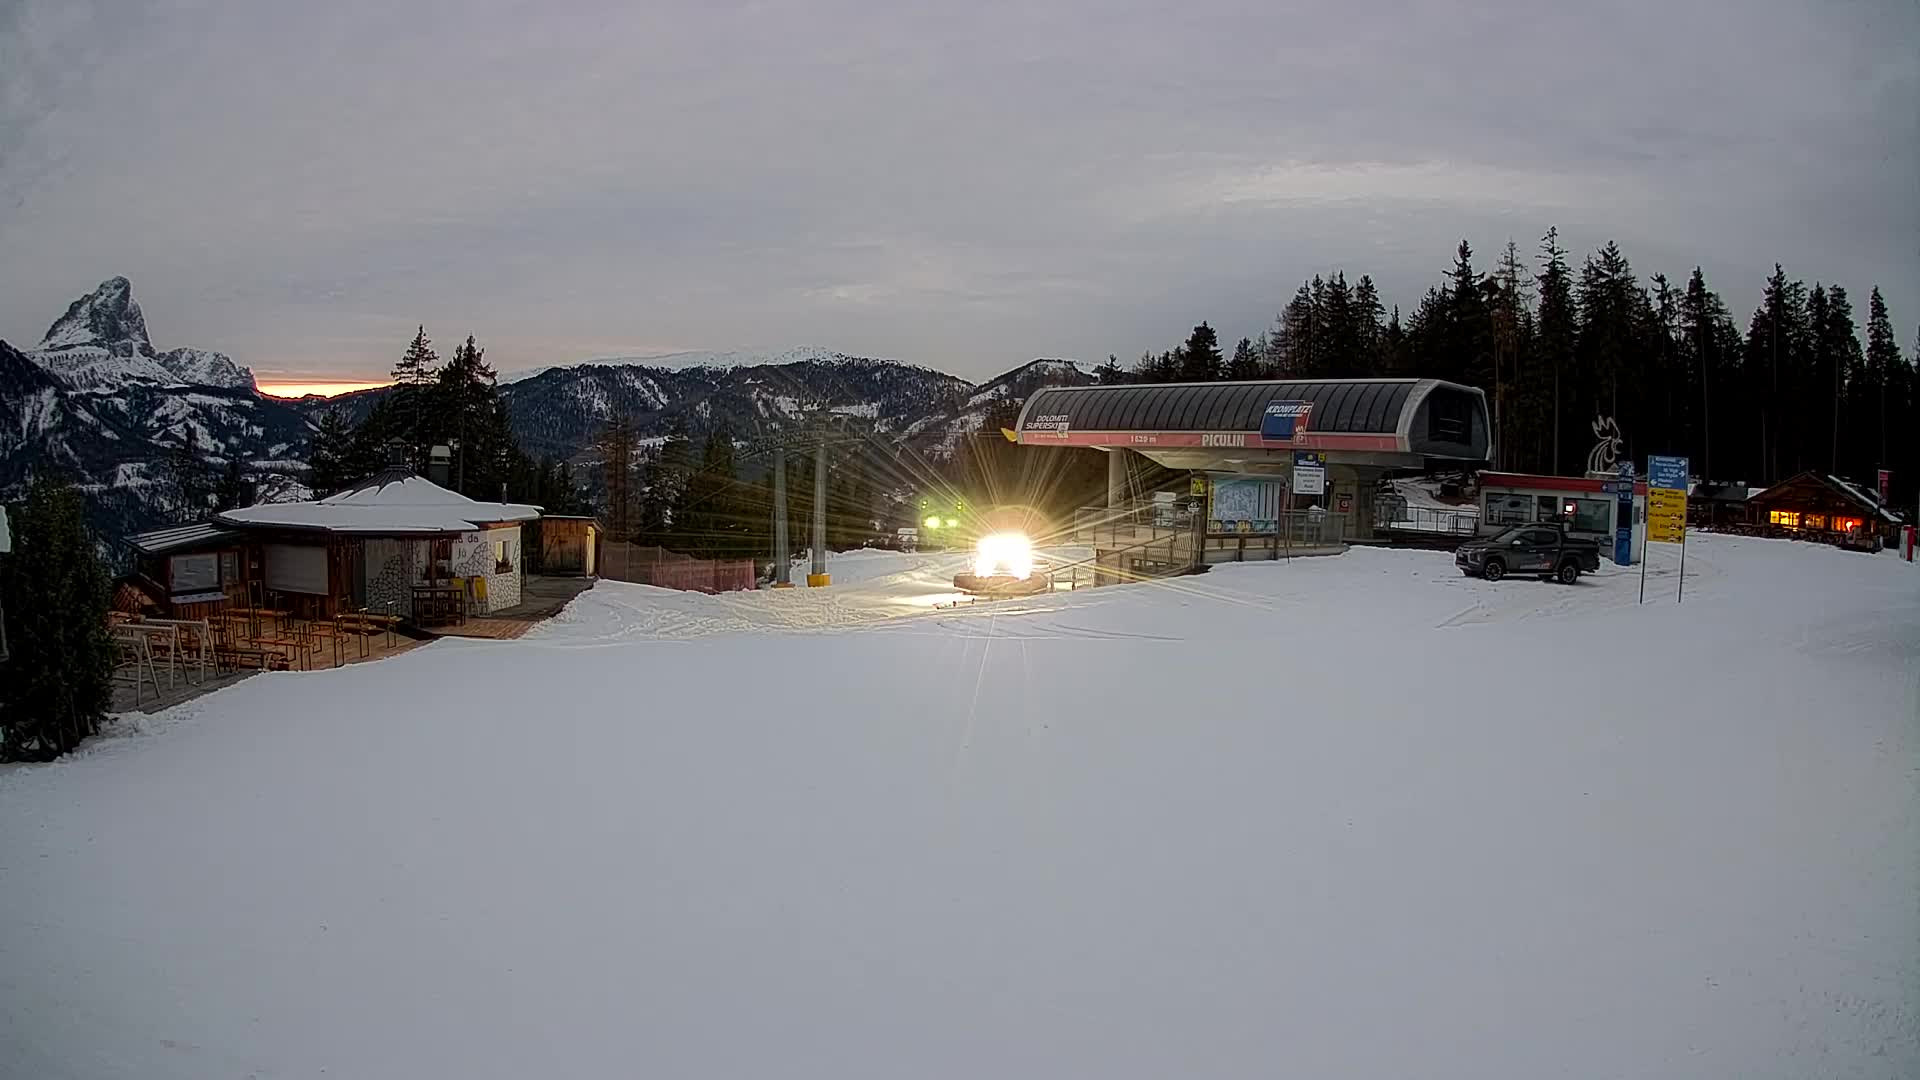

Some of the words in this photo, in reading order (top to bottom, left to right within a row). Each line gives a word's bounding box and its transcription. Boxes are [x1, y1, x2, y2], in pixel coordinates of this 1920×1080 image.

[1265, 405, 1312, 414] KRONPLATZ
[1025, 422, 1058, 430] SUPERSKI
[1201, 434, 1245, 447] PICULIN
